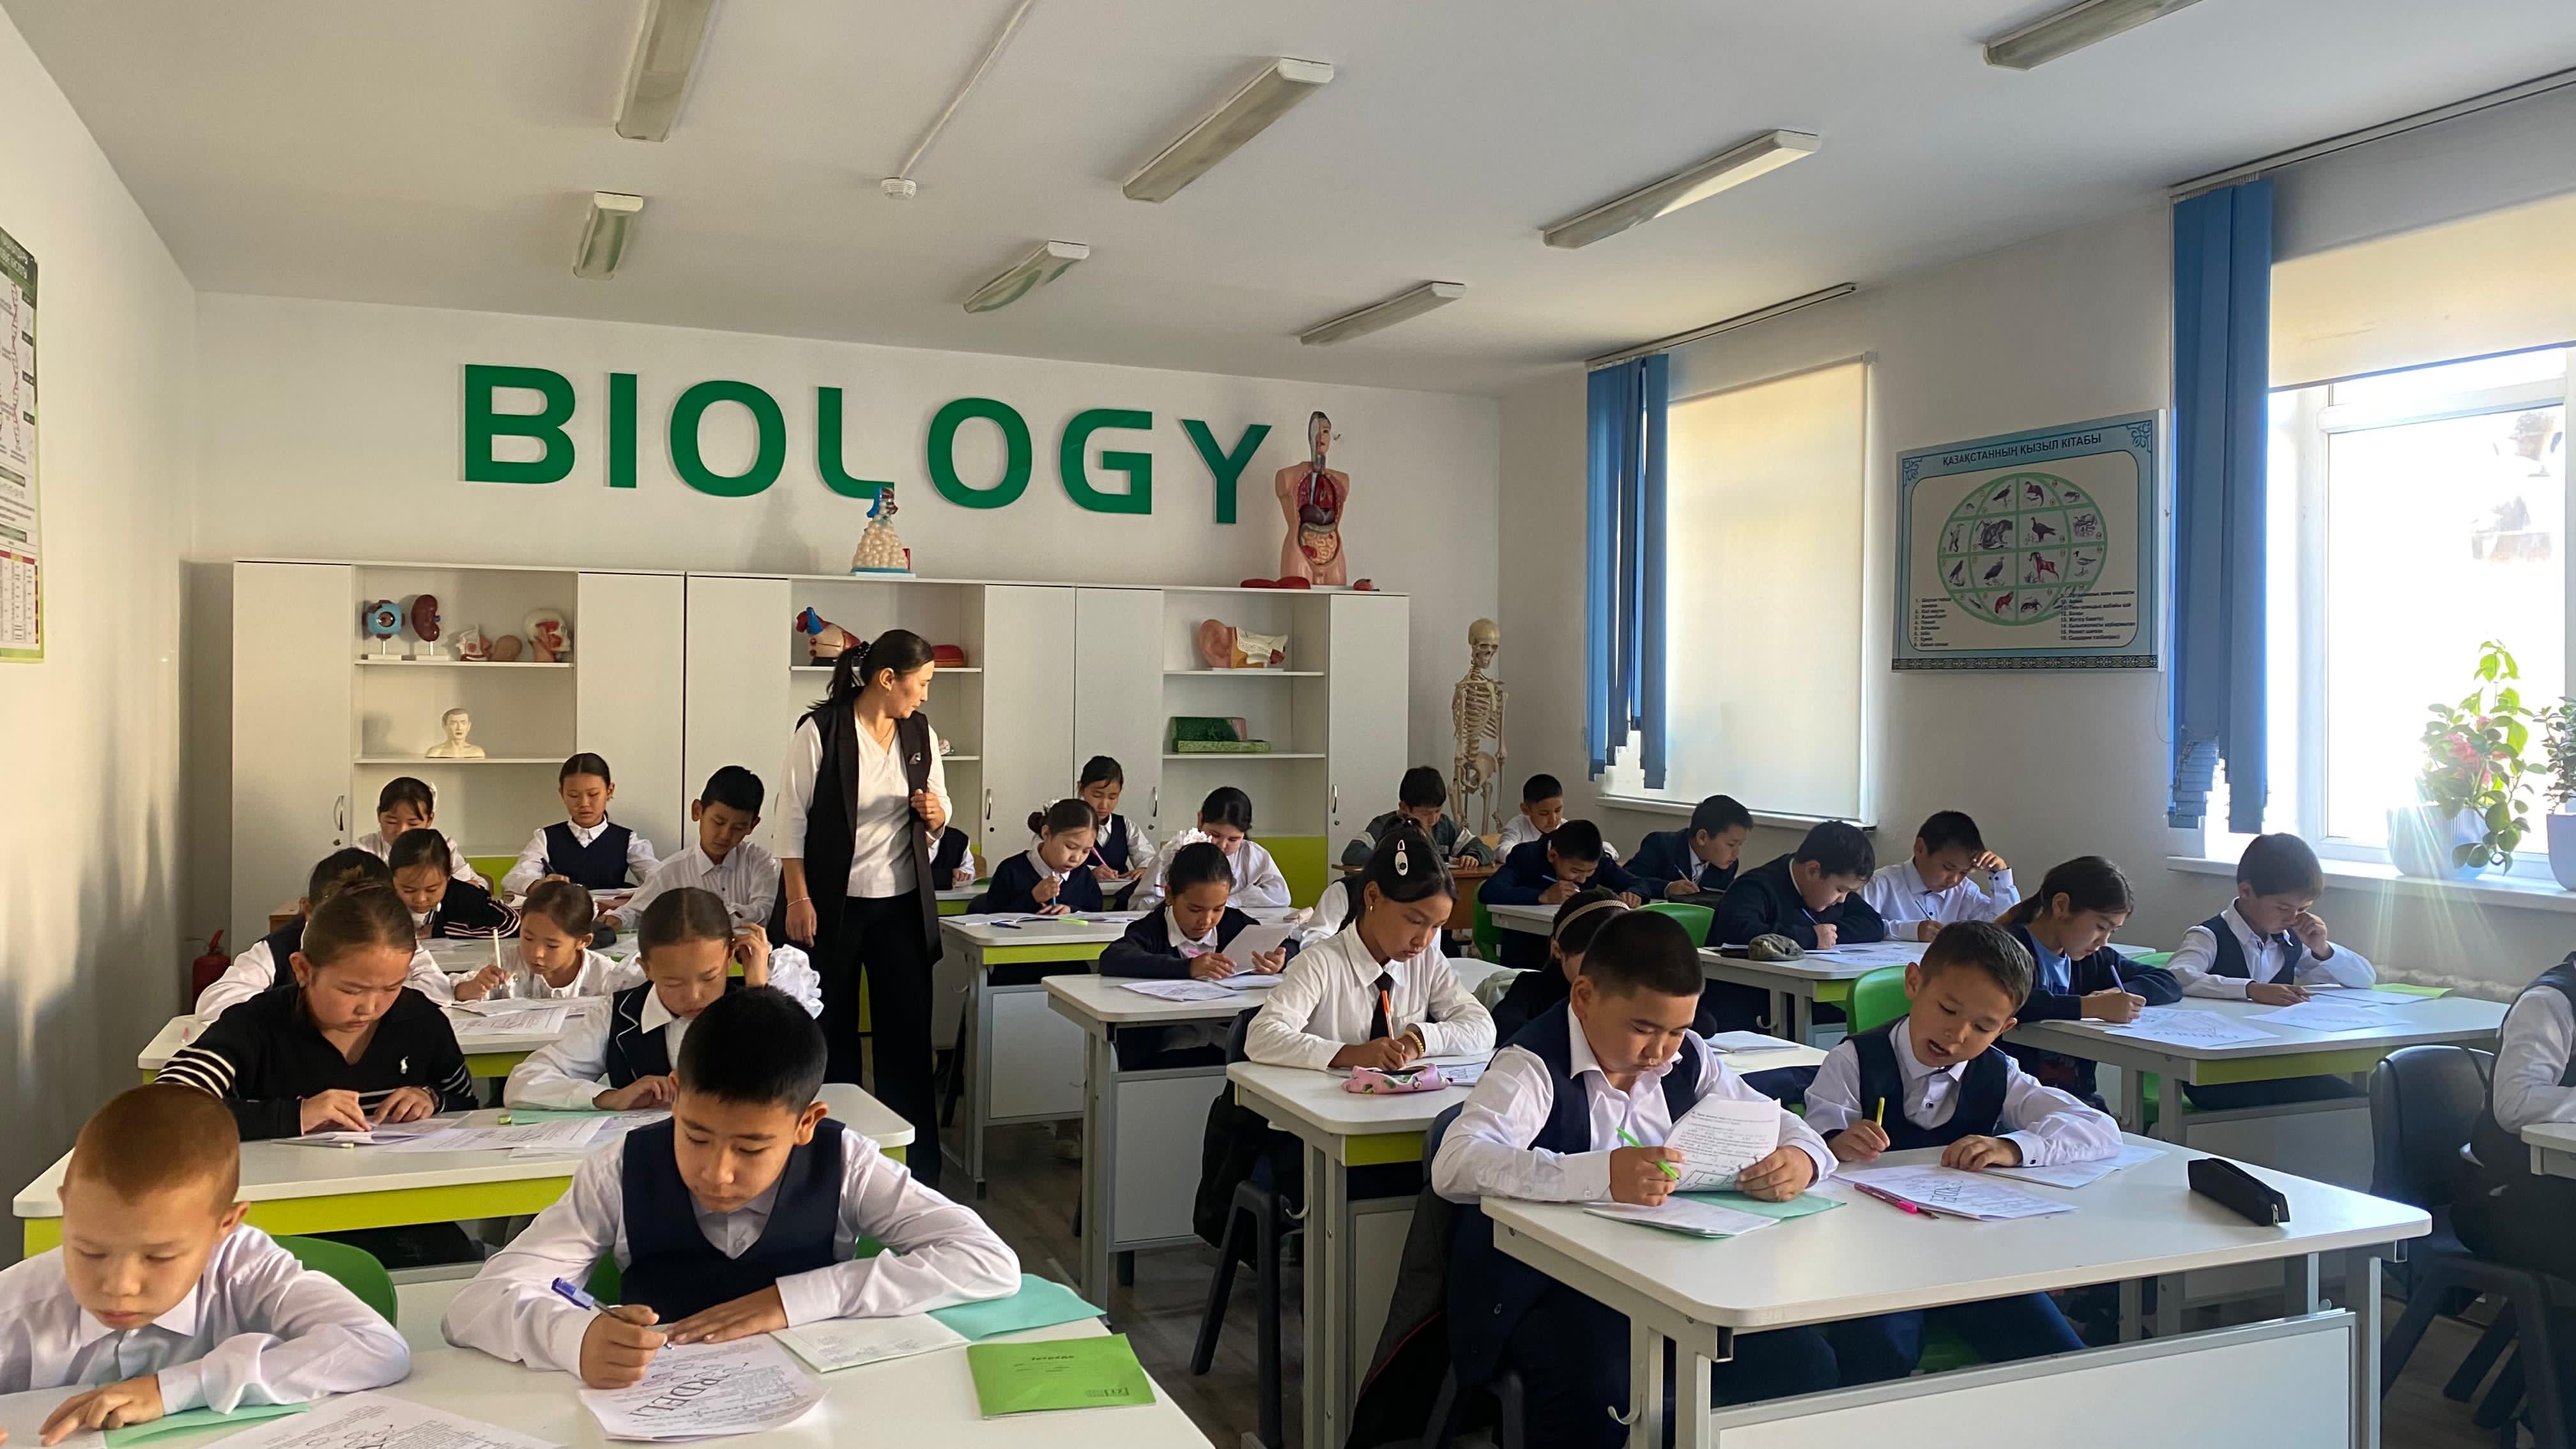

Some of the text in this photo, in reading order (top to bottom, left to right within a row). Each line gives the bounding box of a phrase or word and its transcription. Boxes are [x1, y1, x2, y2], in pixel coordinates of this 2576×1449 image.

[464, 363, 1272, 525] BIOLOGY
[1942, 433, 2101, 467] ҚАЗАҚСТАННЫҢ ҚЫЗЫЛ КІТАБЫ
